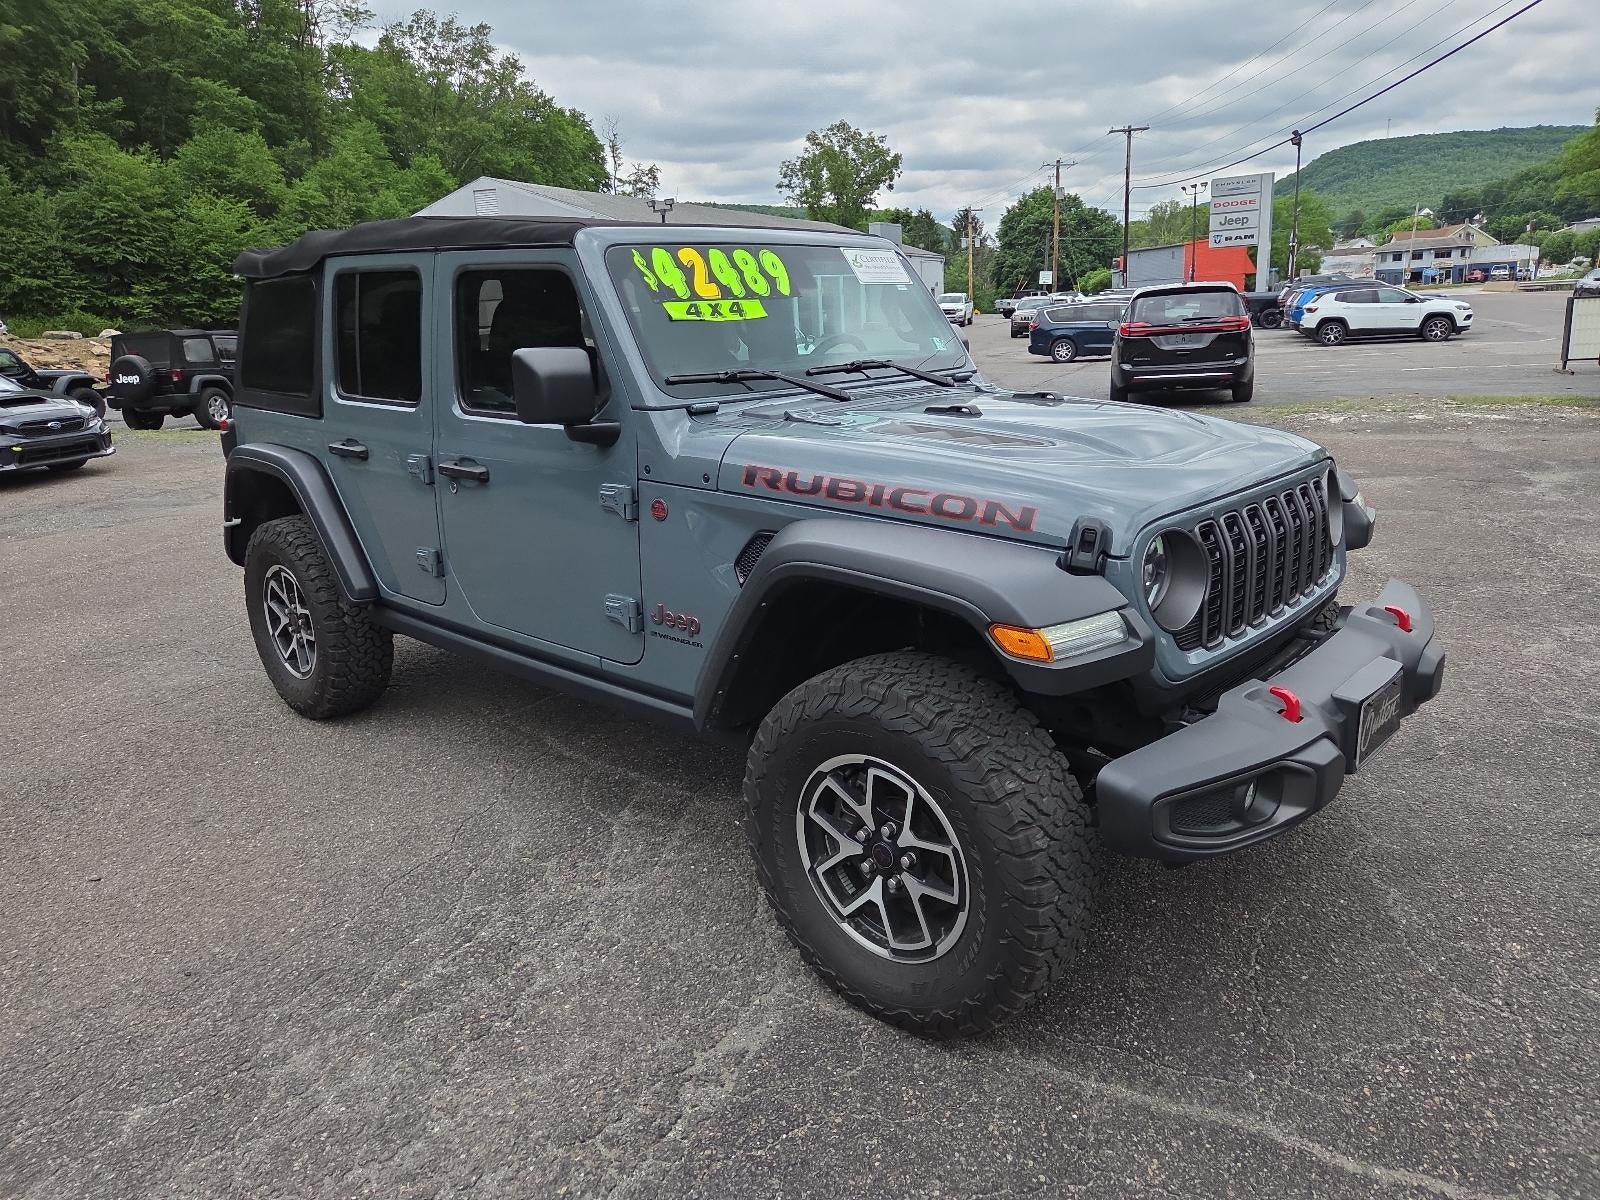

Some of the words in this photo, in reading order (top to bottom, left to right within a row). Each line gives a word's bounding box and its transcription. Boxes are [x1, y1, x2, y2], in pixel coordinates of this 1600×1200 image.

[1213, 199, 1257, 208] DODGE
[1218, 215, 1250, 227] Jeep
[1224, 233, 1255, 242] RAM
[631, 247, 790, 299] $42489
[116, 373, 140, 385] Jeep
[741, 463, 1039, 533] RUBICON
[651, 603, 700, 637] Jeep
[657, 632, 704, 649] WRANGLER
